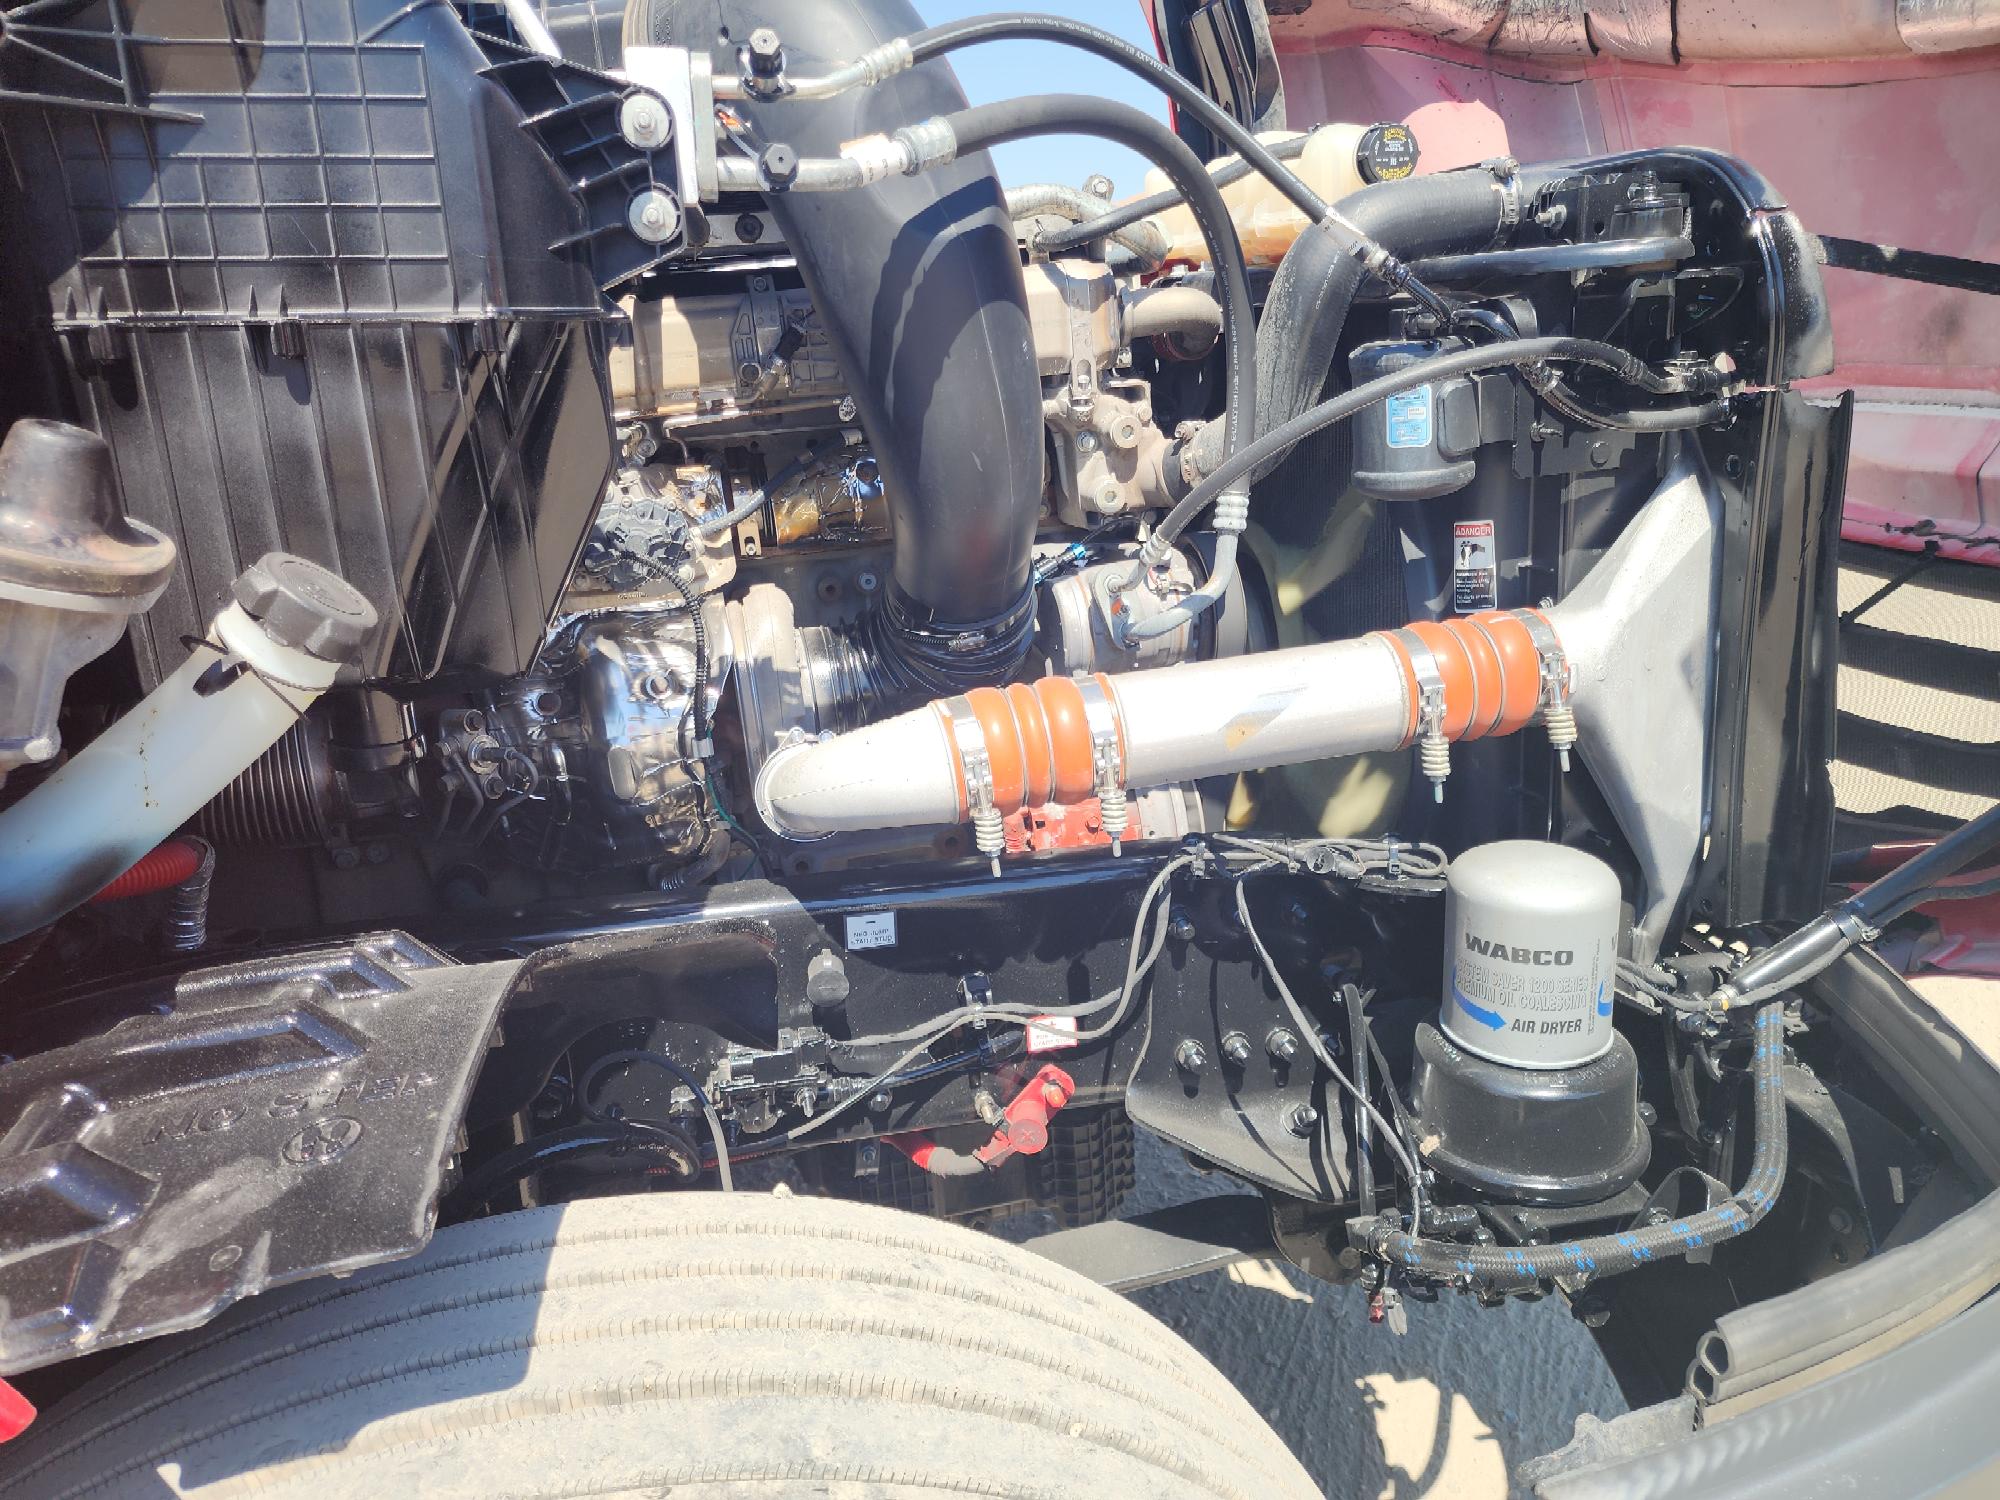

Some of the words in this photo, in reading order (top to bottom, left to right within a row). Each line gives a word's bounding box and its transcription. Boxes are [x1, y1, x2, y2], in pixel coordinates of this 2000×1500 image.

[1461, 526, 1491, 536] DANGER
[1465, 933, 1574, 966] WABCO
[1455, 958, 1490, 984] SYSTEM
[1492, 969, 1525, 992] SAVER
[1528, 976, 1555, 994] 1200
[1556, 975, 1589, 994] SERIES
[1499, 990, 1517, 1008] OIL
[1511, 1018, 1536, 1034] AIR
[1539, 1018, 1583, 1036] DRYER
[142, 1104, 248, 1146] NO
[267, 1071, 443, 1118] STEP
